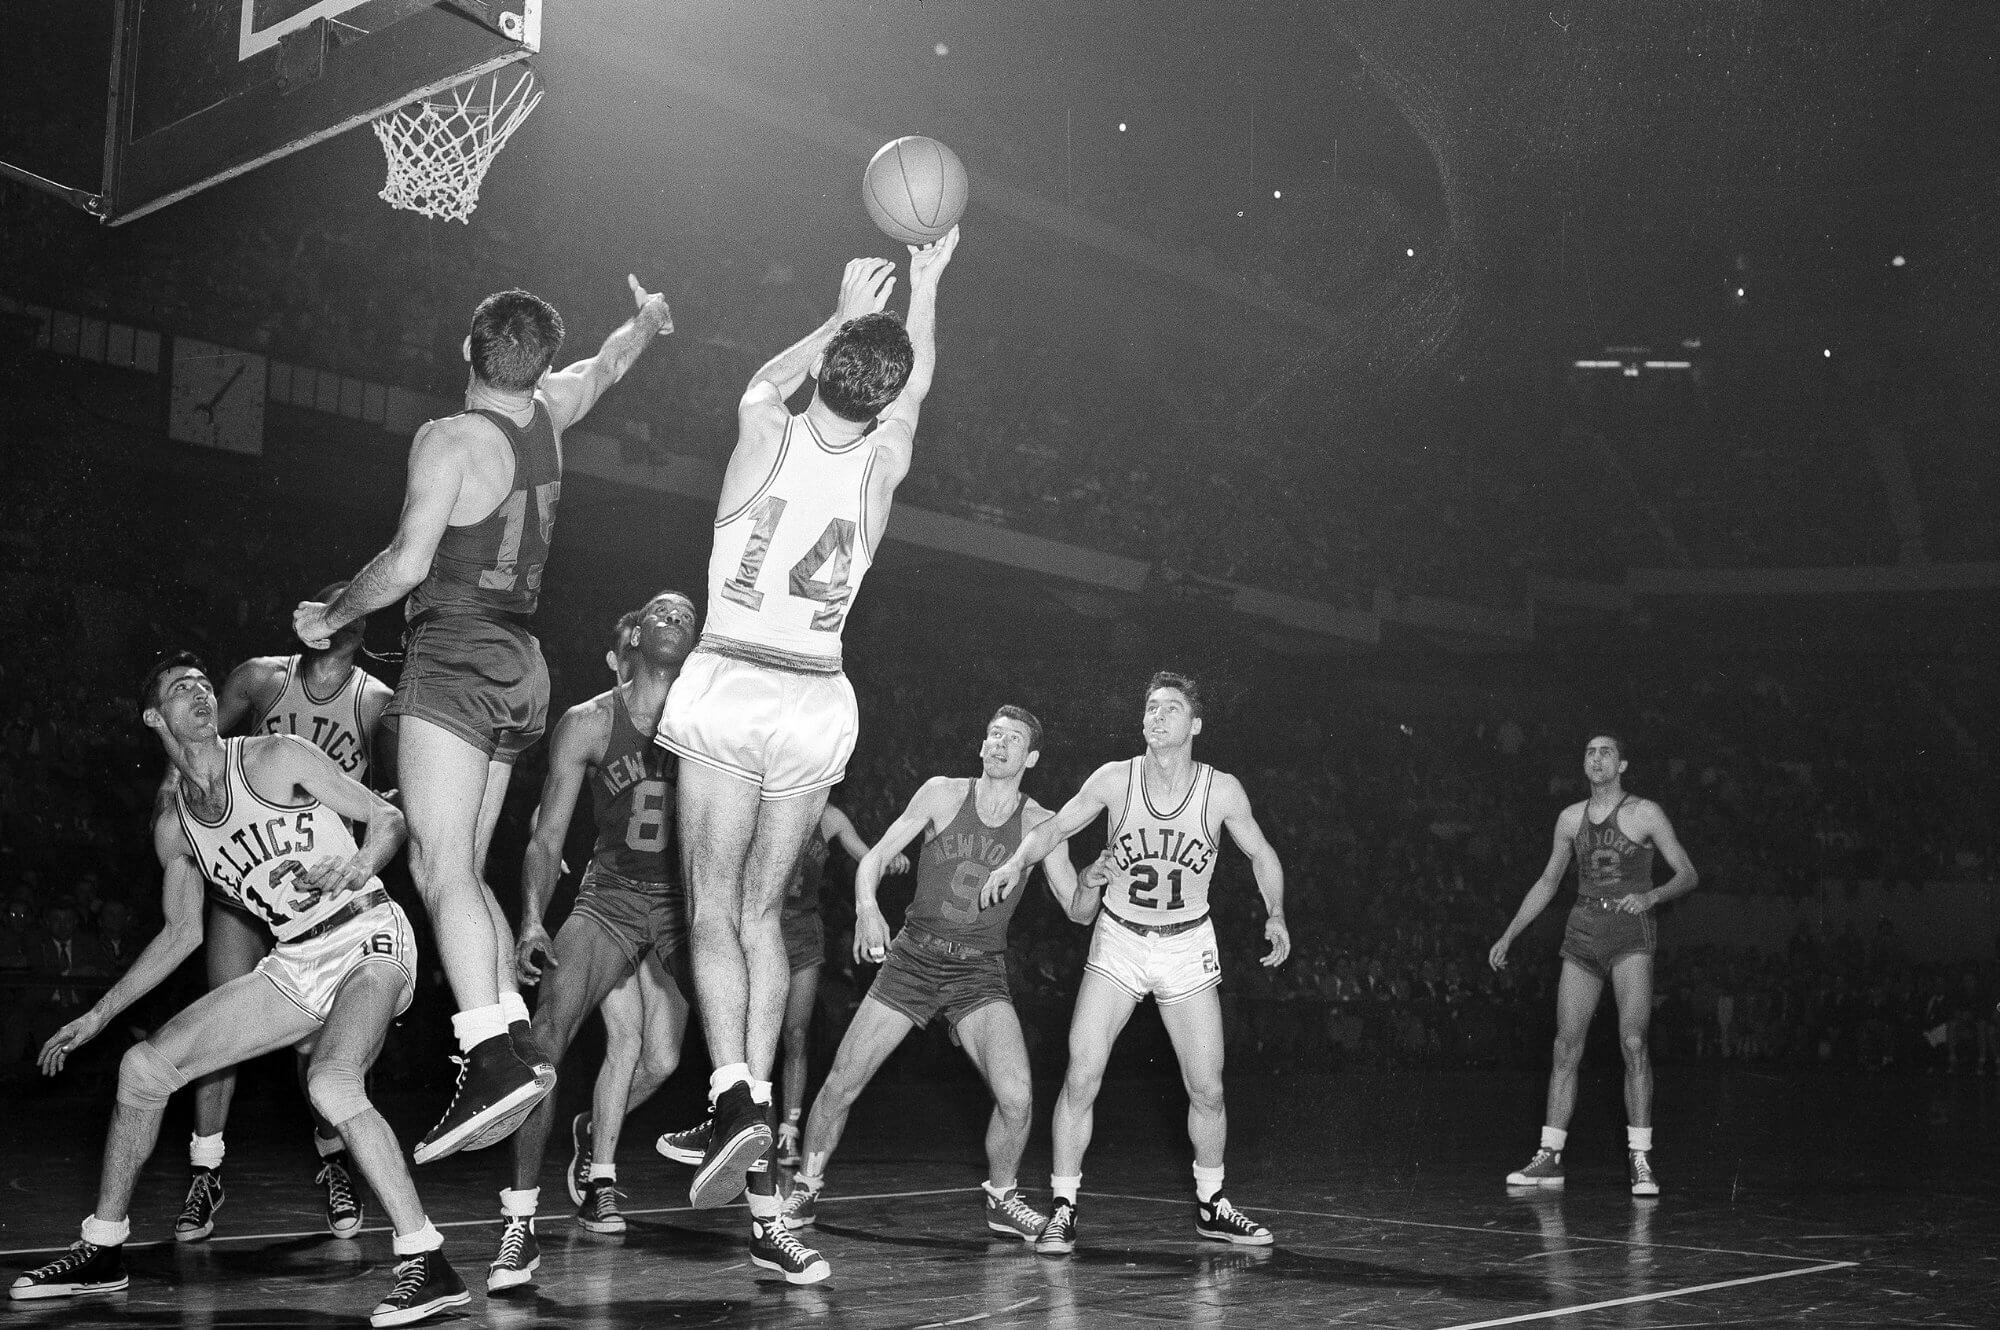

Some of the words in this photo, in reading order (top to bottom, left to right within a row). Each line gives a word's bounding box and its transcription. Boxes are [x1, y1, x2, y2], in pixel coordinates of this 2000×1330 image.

[720, 495, 856, 633] 14
[257, 712, 364, 773] ELTICS
[213, 812, 314, 891] ELTICS
[979, 836, 1007, 866] YO
[1112, 828, 1213, 874] CELTICS
[246, 859, 322, 926] 13
[940, 859, 992, 925] 9
[1129, 864, 1185, 910] 21
[360, 933, 393, 956] 16
